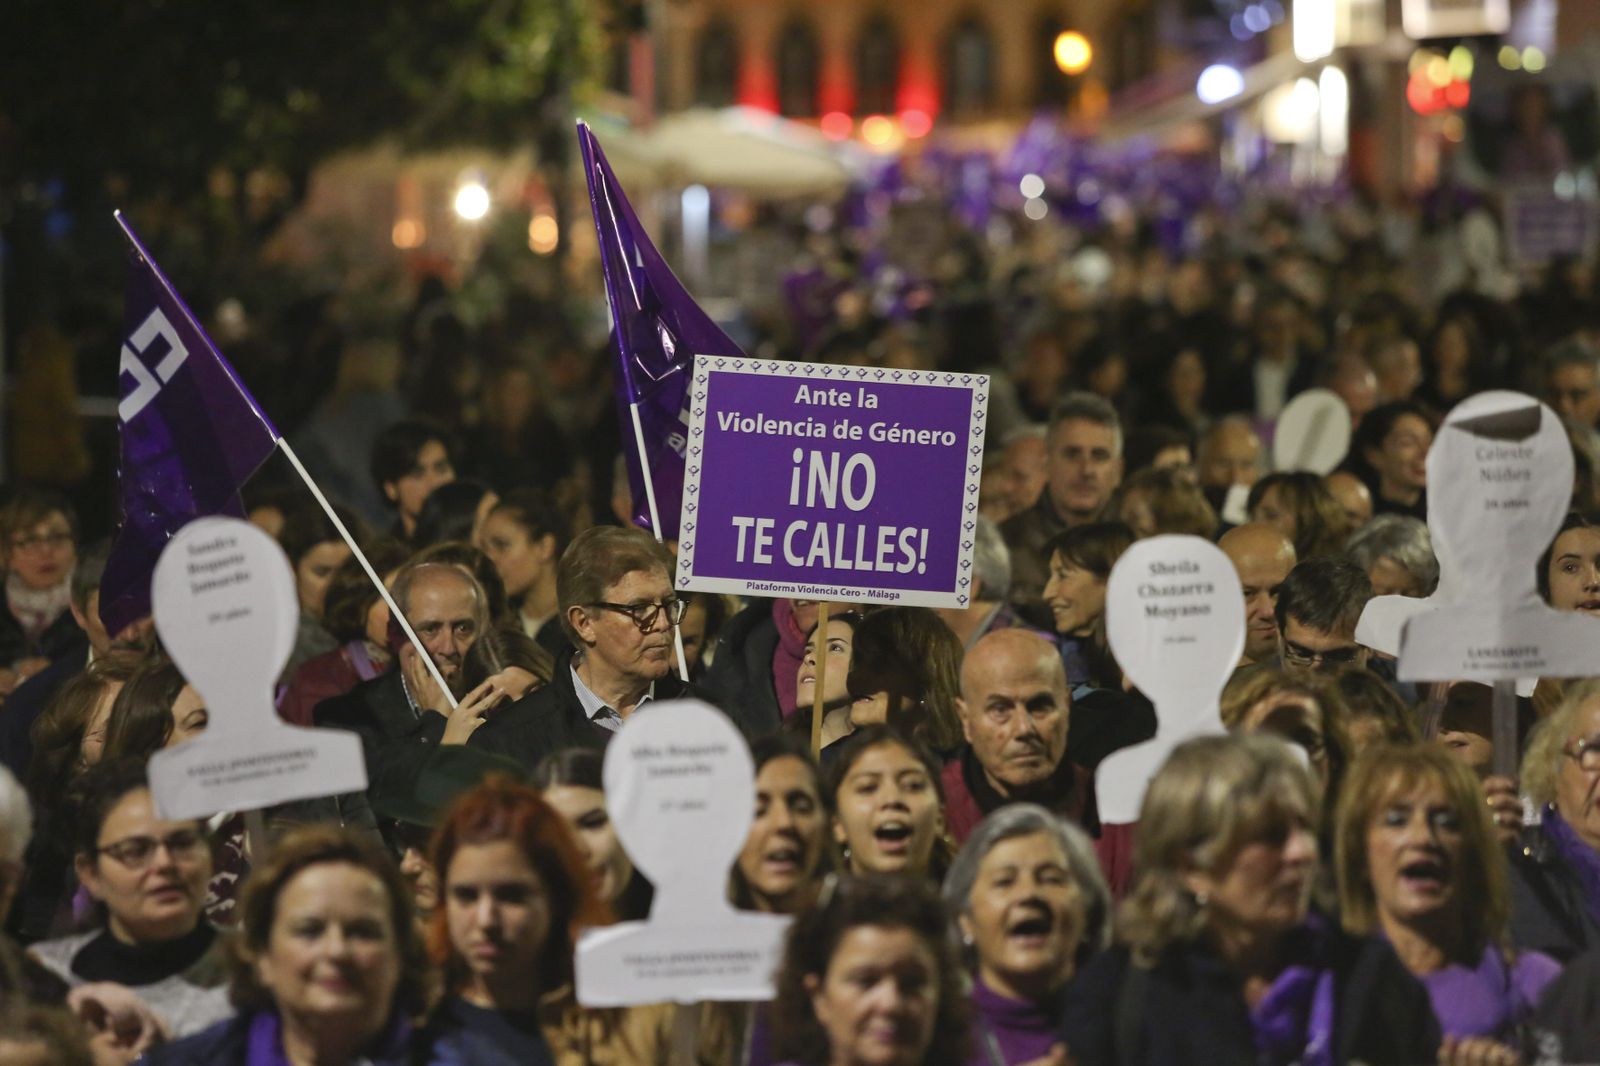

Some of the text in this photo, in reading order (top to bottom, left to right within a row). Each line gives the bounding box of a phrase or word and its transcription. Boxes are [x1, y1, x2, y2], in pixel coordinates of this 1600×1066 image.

[794, 384, 878, 409] Ante la
[717, 411, 956, 446] Violencia de Género
[789, 447, 877, 511] ¡NO
[732, 516, 929, 575] TE CALLES!
[746, 581, 796, 594] Plataforma
[797, 584, 838, 597] Violencia
[839, 588, 861, 598] Cero
[867, 589, 900, 600] Málaga
